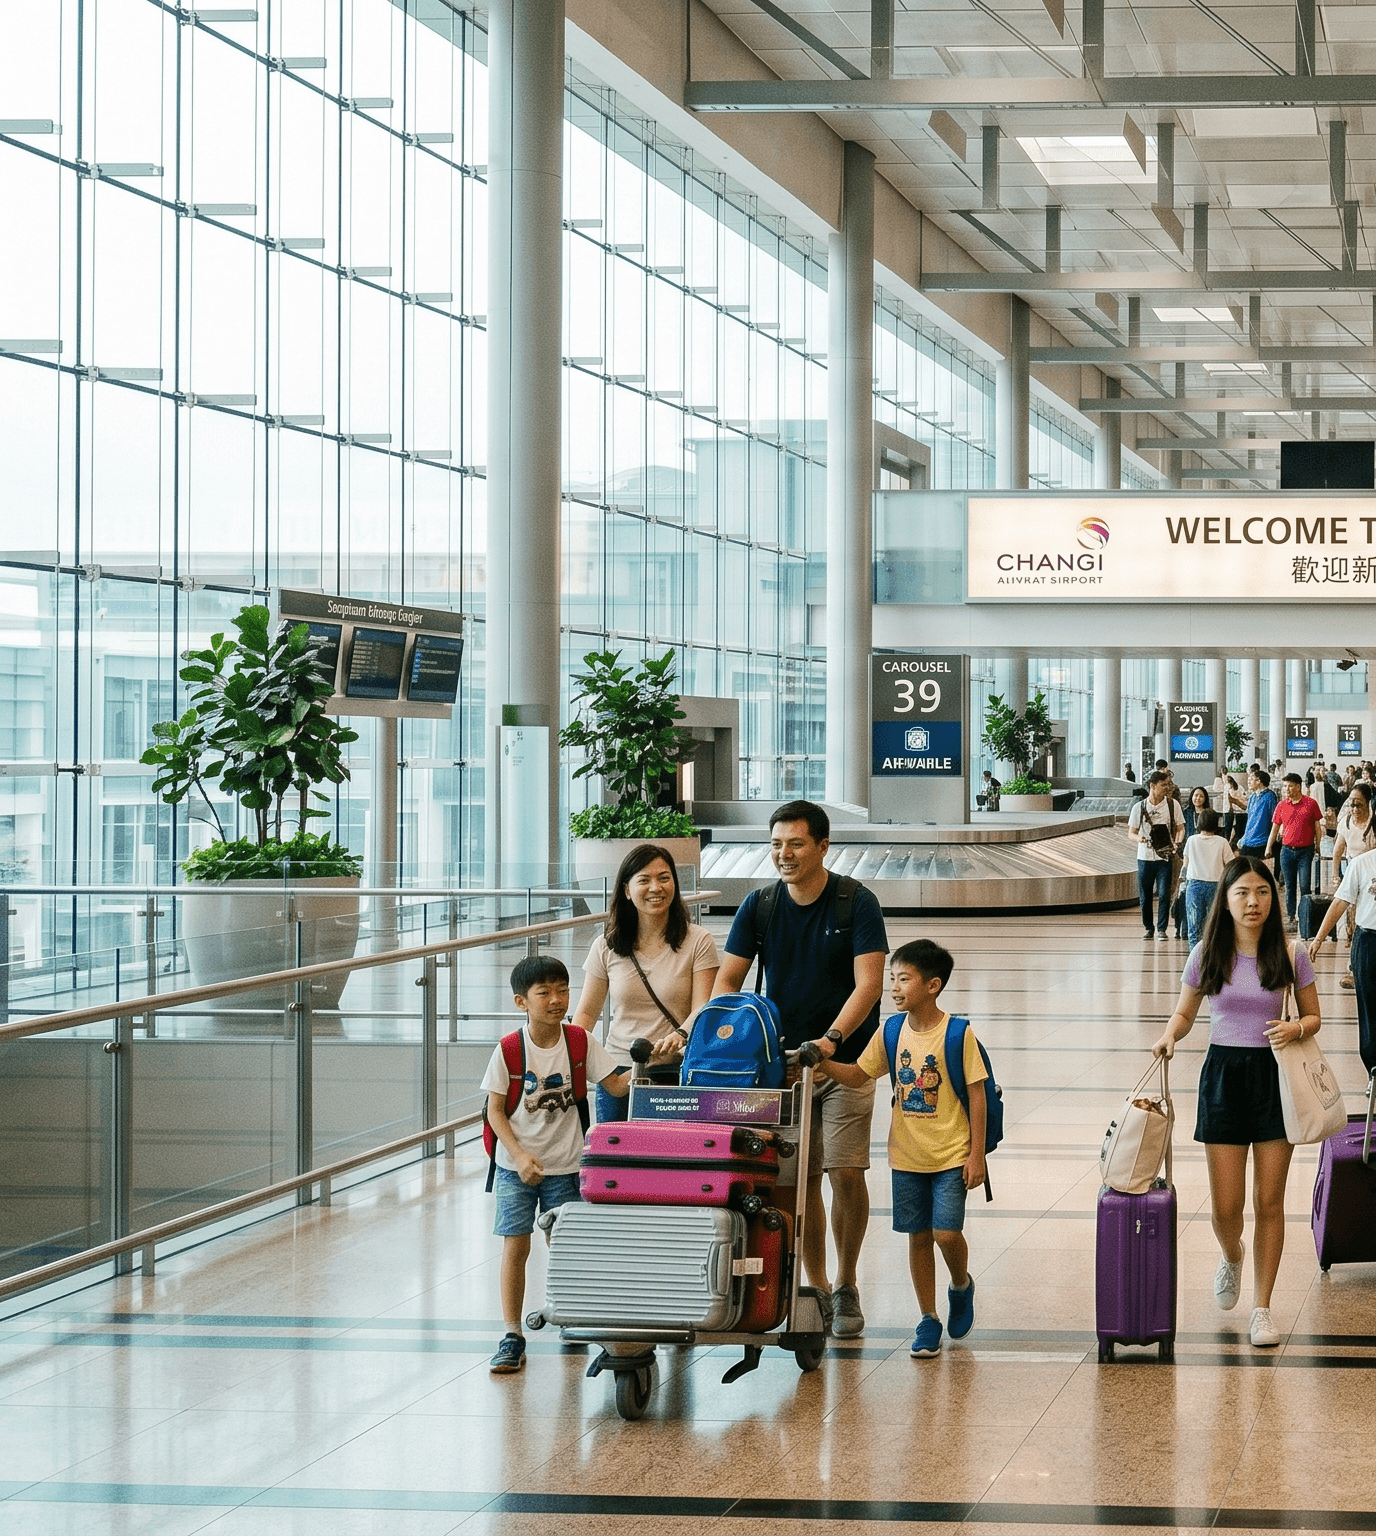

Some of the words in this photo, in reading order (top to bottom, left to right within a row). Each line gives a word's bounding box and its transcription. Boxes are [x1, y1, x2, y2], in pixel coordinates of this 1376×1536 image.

[1165, 516, 1348, 545] WELCOME
[996, 553, 1103, 572] CHANGI
[1050, 576, 1104, 585] SIRPORT
[882, 661, 952, 673] CAROUSEL
[893, 679, 942, 713] 39
[1179, 713, 1204, 733] 29
[1344, 730, 1355, 741] 13
